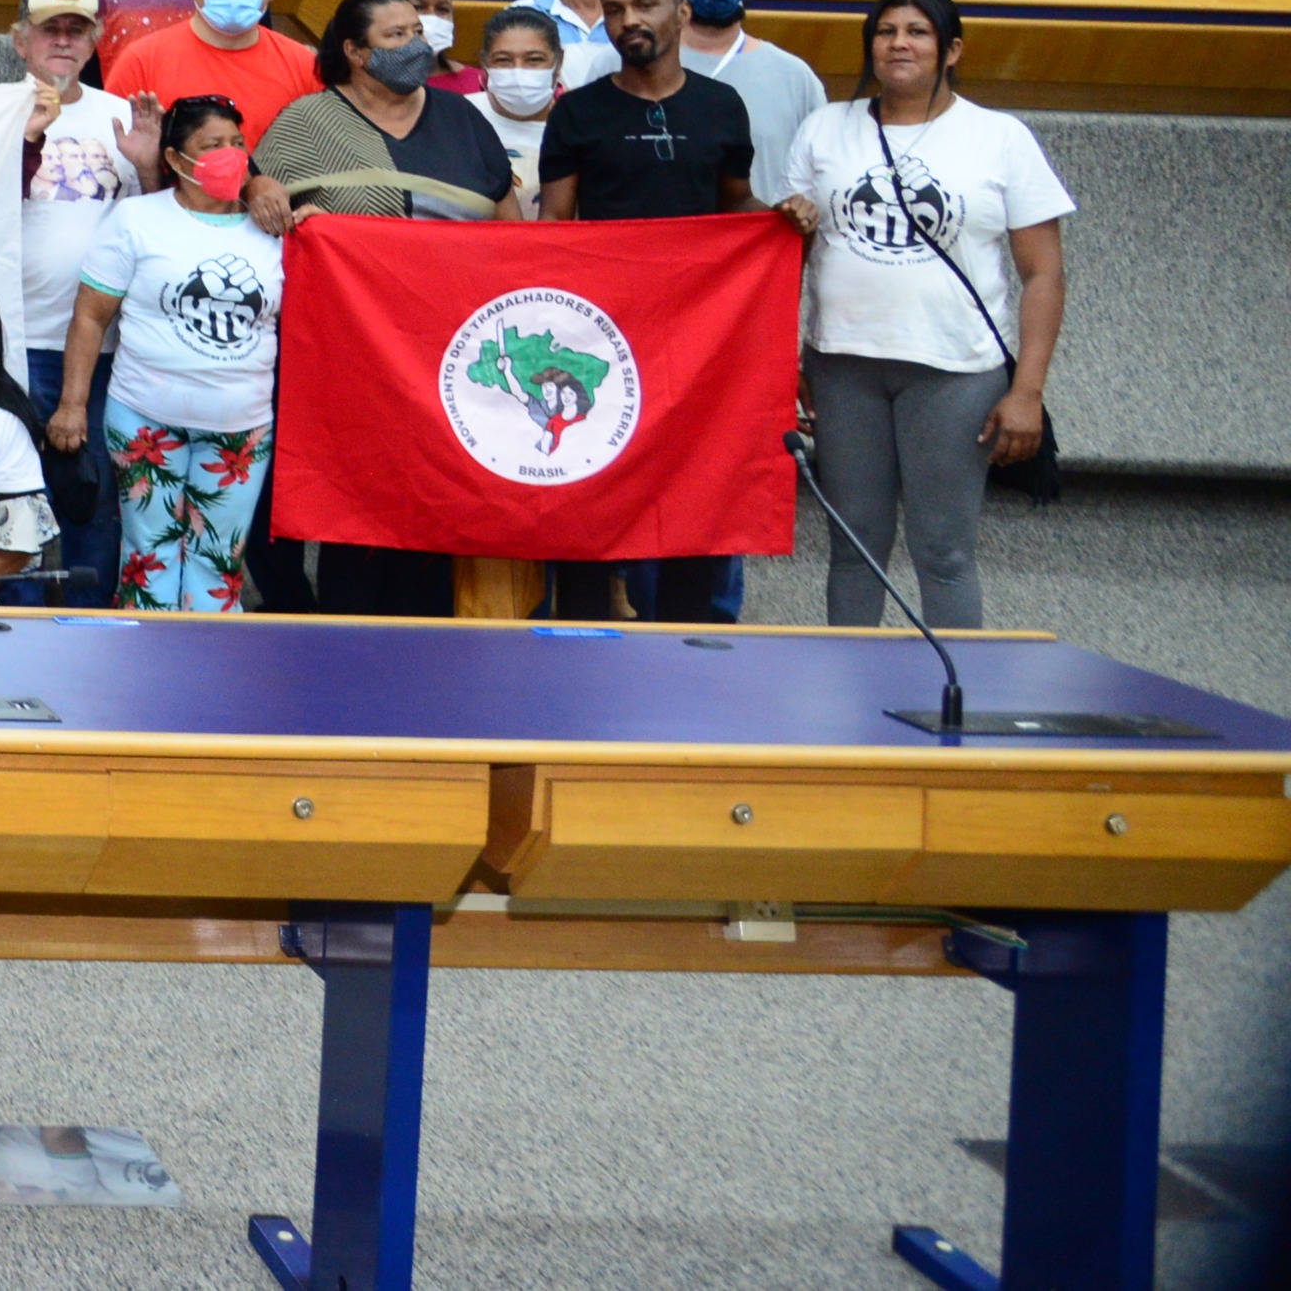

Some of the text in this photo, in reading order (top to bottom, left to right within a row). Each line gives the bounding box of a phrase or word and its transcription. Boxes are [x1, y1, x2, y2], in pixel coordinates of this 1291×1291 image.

[444, 292, 635, 449] MOVIMENTO DOS TRABALHADORES RURAIS SEM TERRA
[519, 465, 568, 478] BRASIL
